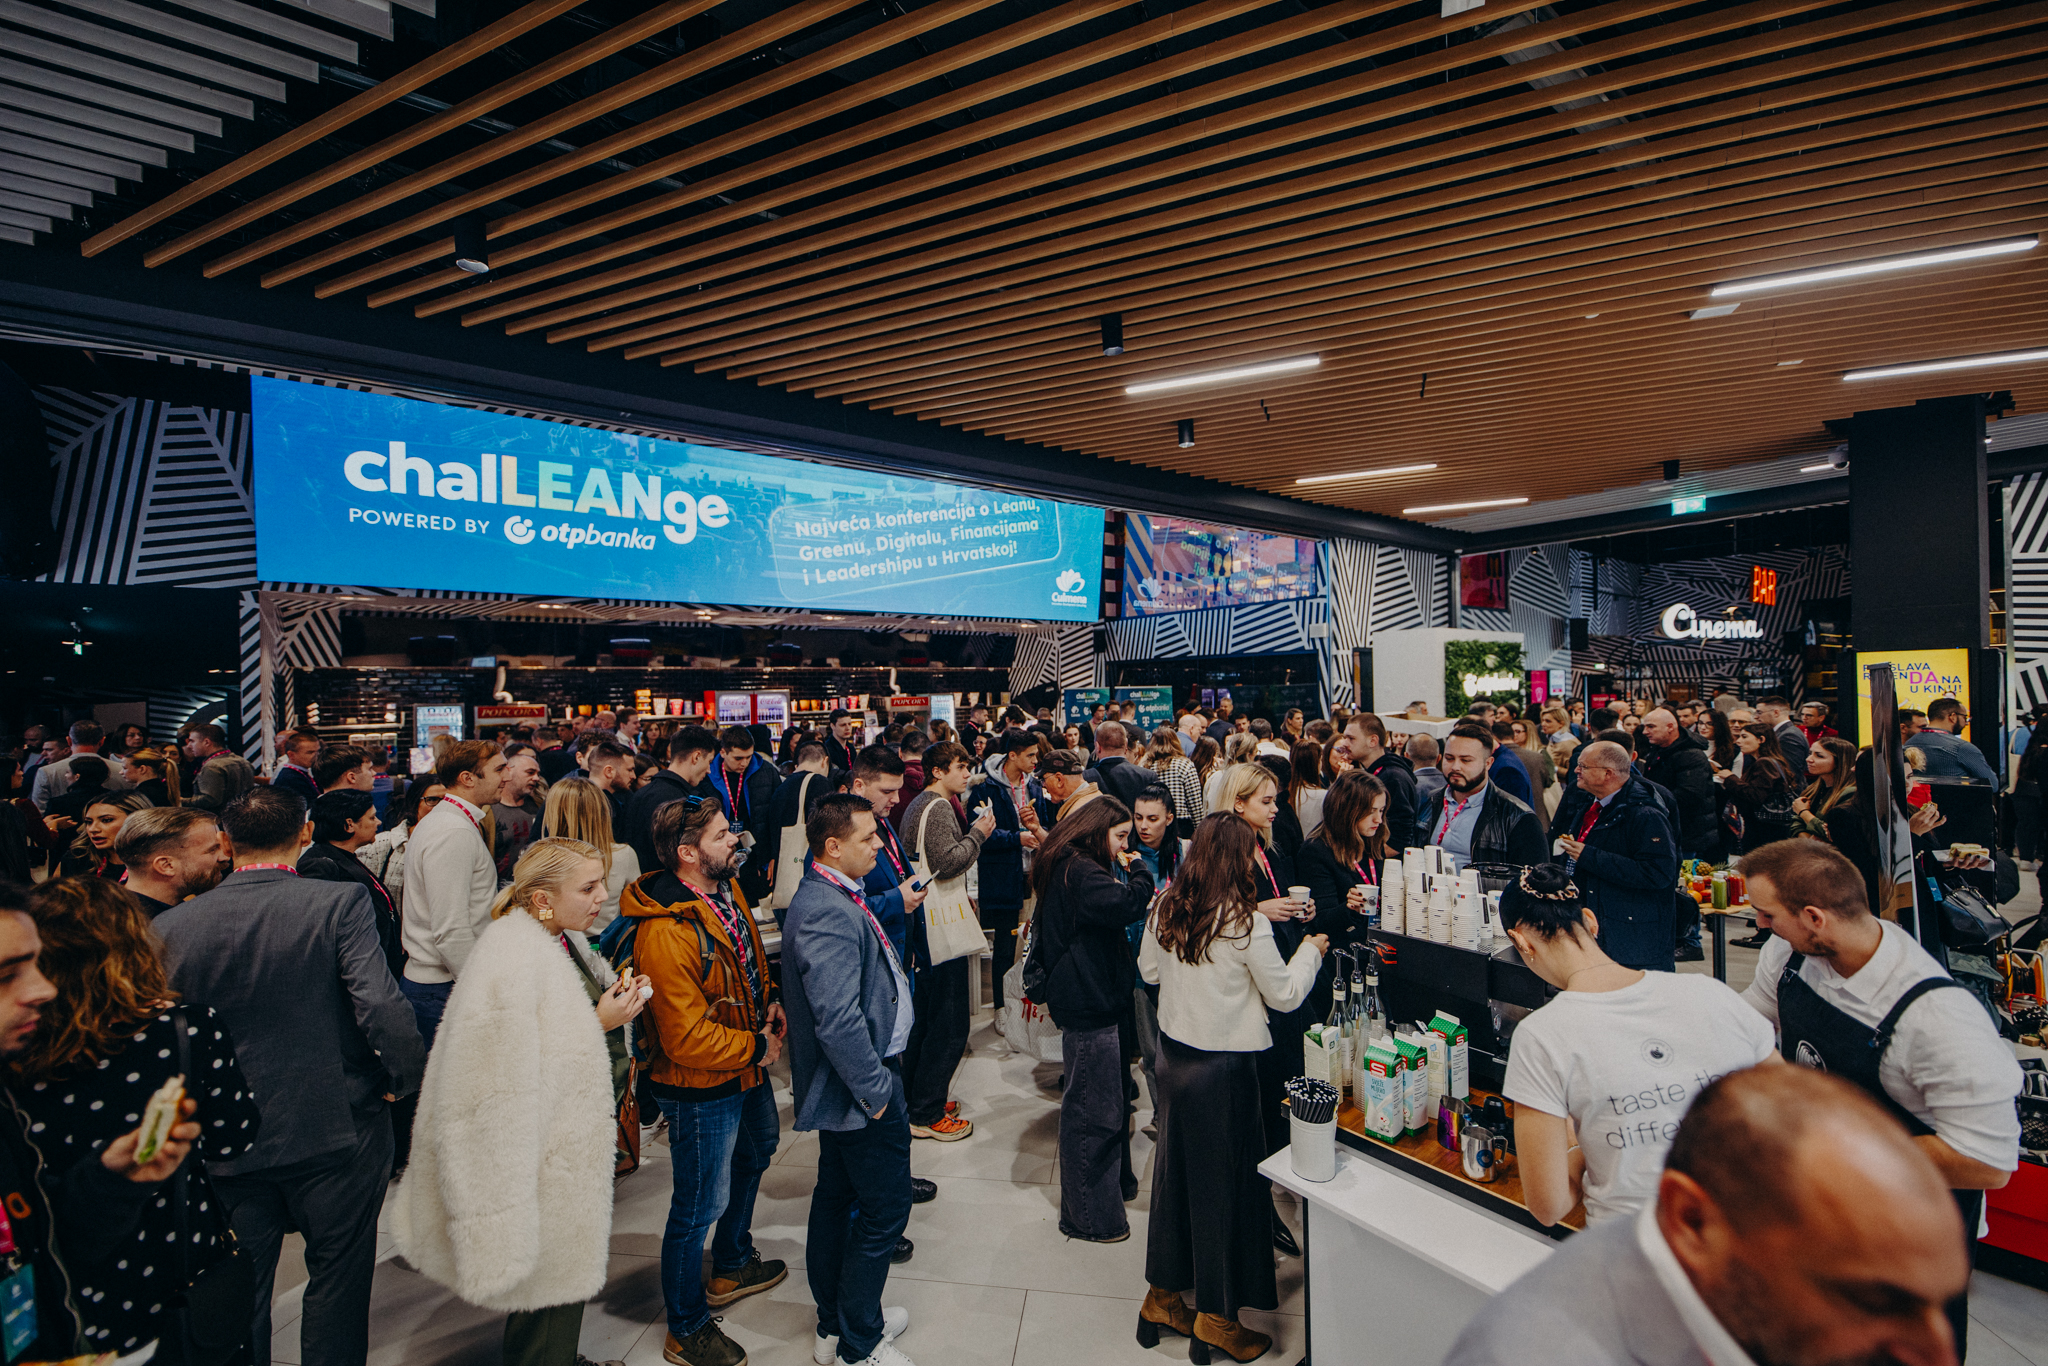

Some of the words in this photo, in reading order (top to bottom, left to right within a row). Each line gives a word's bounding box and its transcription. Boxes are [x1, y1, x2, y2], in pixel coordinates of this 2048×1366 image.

[344, 441, 729, 544] chalLEANge
[349, 508, 456, 531] POWERED
[465, 519, 490, 534] BY
[796, 513, 870, 538] Najveća
[876, 502, 975, 529] konferencija
[980, 505, 990, 517] o
[993, 498, 1040, 516] Leanu,
[541, 523, 656, 550] otpbanka
[799, 543, 871, 562] Greenu,
[876, 529, 947, 553] Digitalu,
[951, 518, 1039, 542] Financijama
[803, 569, 810, 586] i
[816, 554, 923, 585] Leadershipu
[928, 556, 937, 568] u
[942, 541, 1018, 566] Hrvatskoj!
[1051, 591, 1088, 604] Culmena
[1753, 566, 1777, 606] BAR
[1662, 603, 1764, 639] Cinema
[1863, 663, 1931, 672] PSLAVA
[1910, 685, 1919, 693] U
[481, 707, 540, 717] POPCORN
[1607, 1083, 1686, 1115] taste
[1606, 1119, 1684, 1149] diffe
